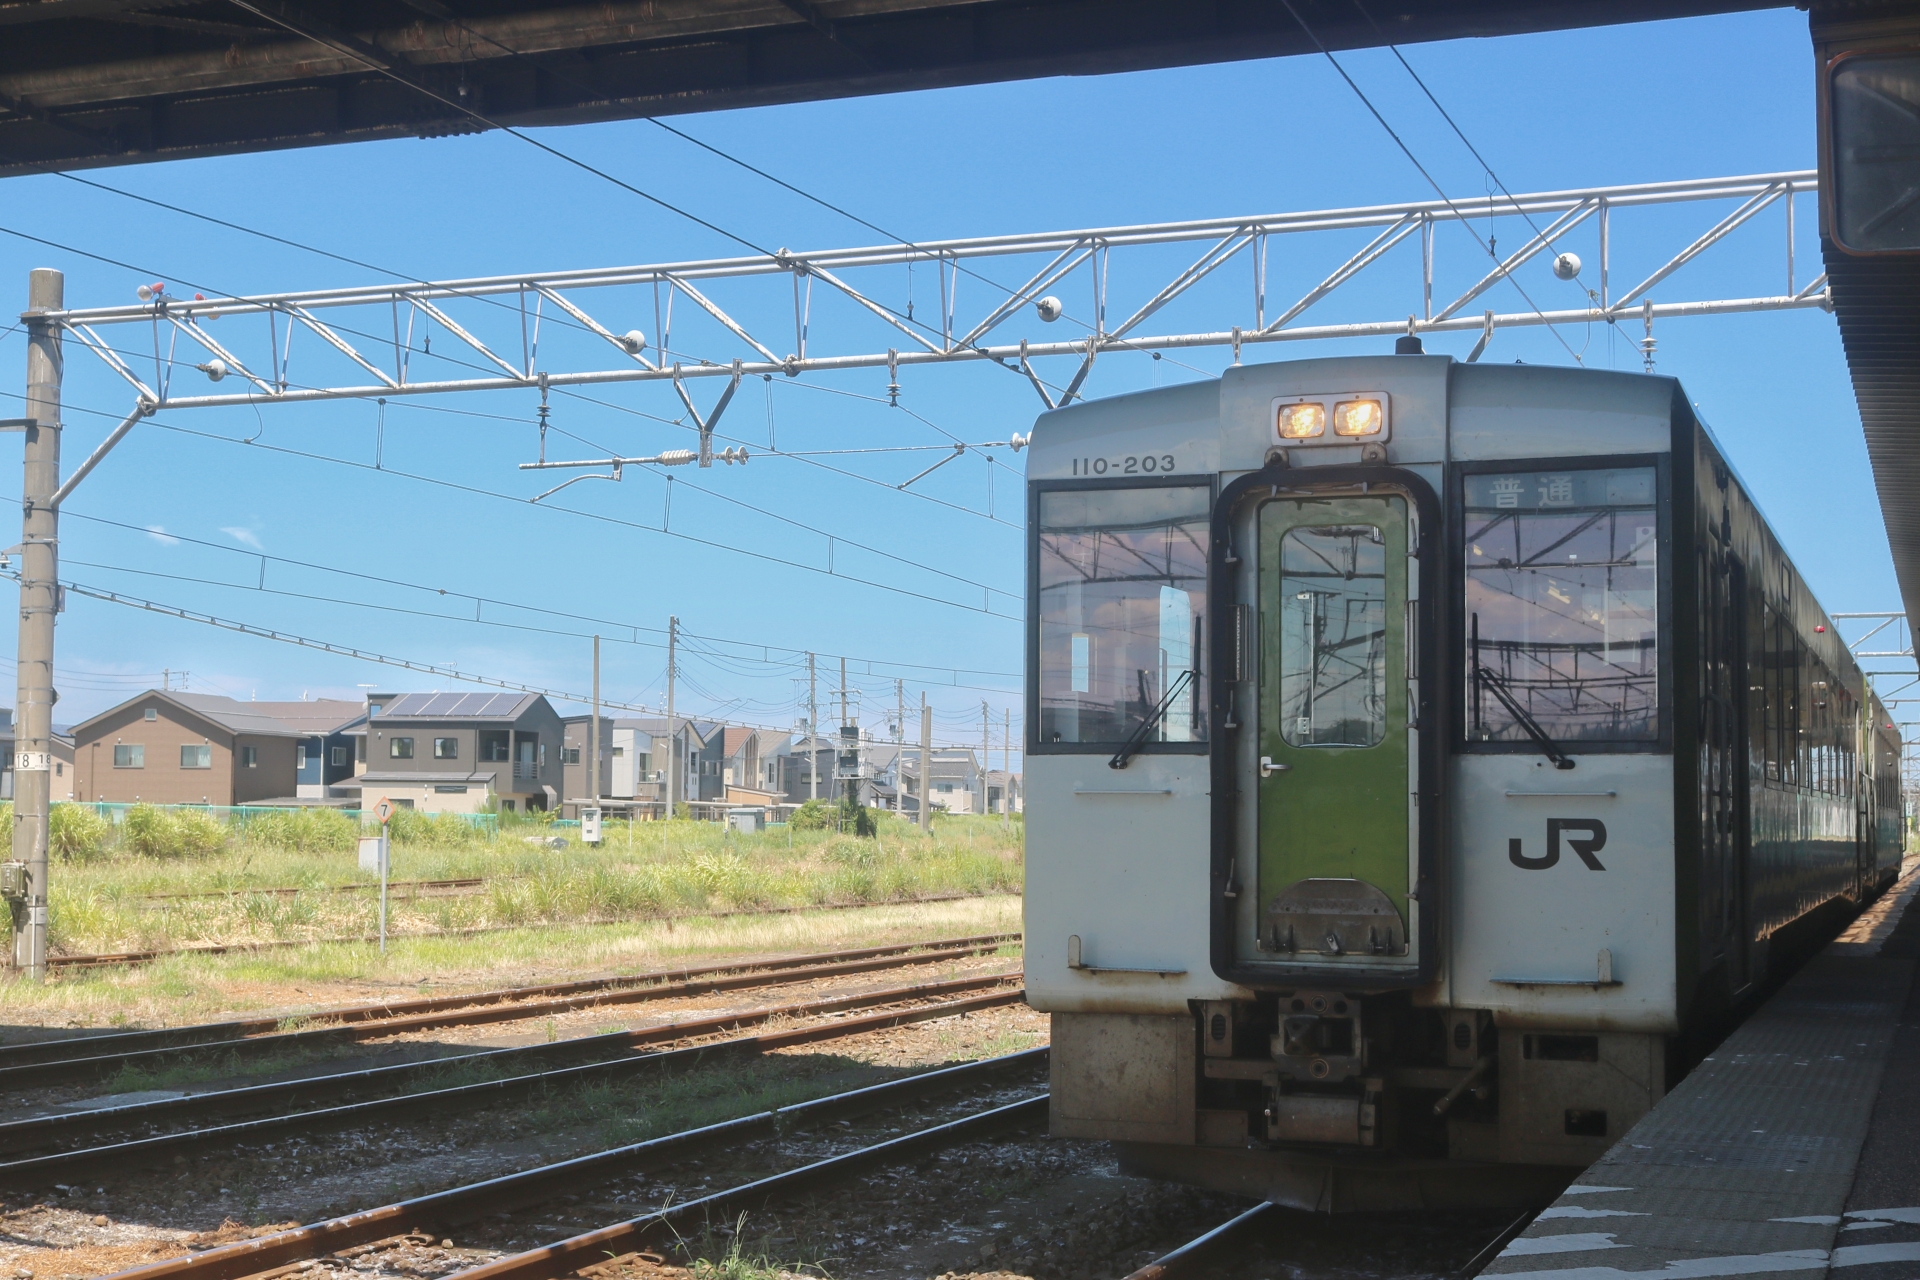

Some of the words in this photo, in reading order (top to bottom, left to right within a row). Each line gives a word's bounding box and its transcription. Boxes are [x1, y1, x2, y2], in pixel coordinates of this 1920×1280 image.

[1073, 455, 1175, 475] 110-203
[1489, 476, 1574, 508] 普通
[380, 804, 388, 817] 7
[1509, 818, 1607, 871] JR
